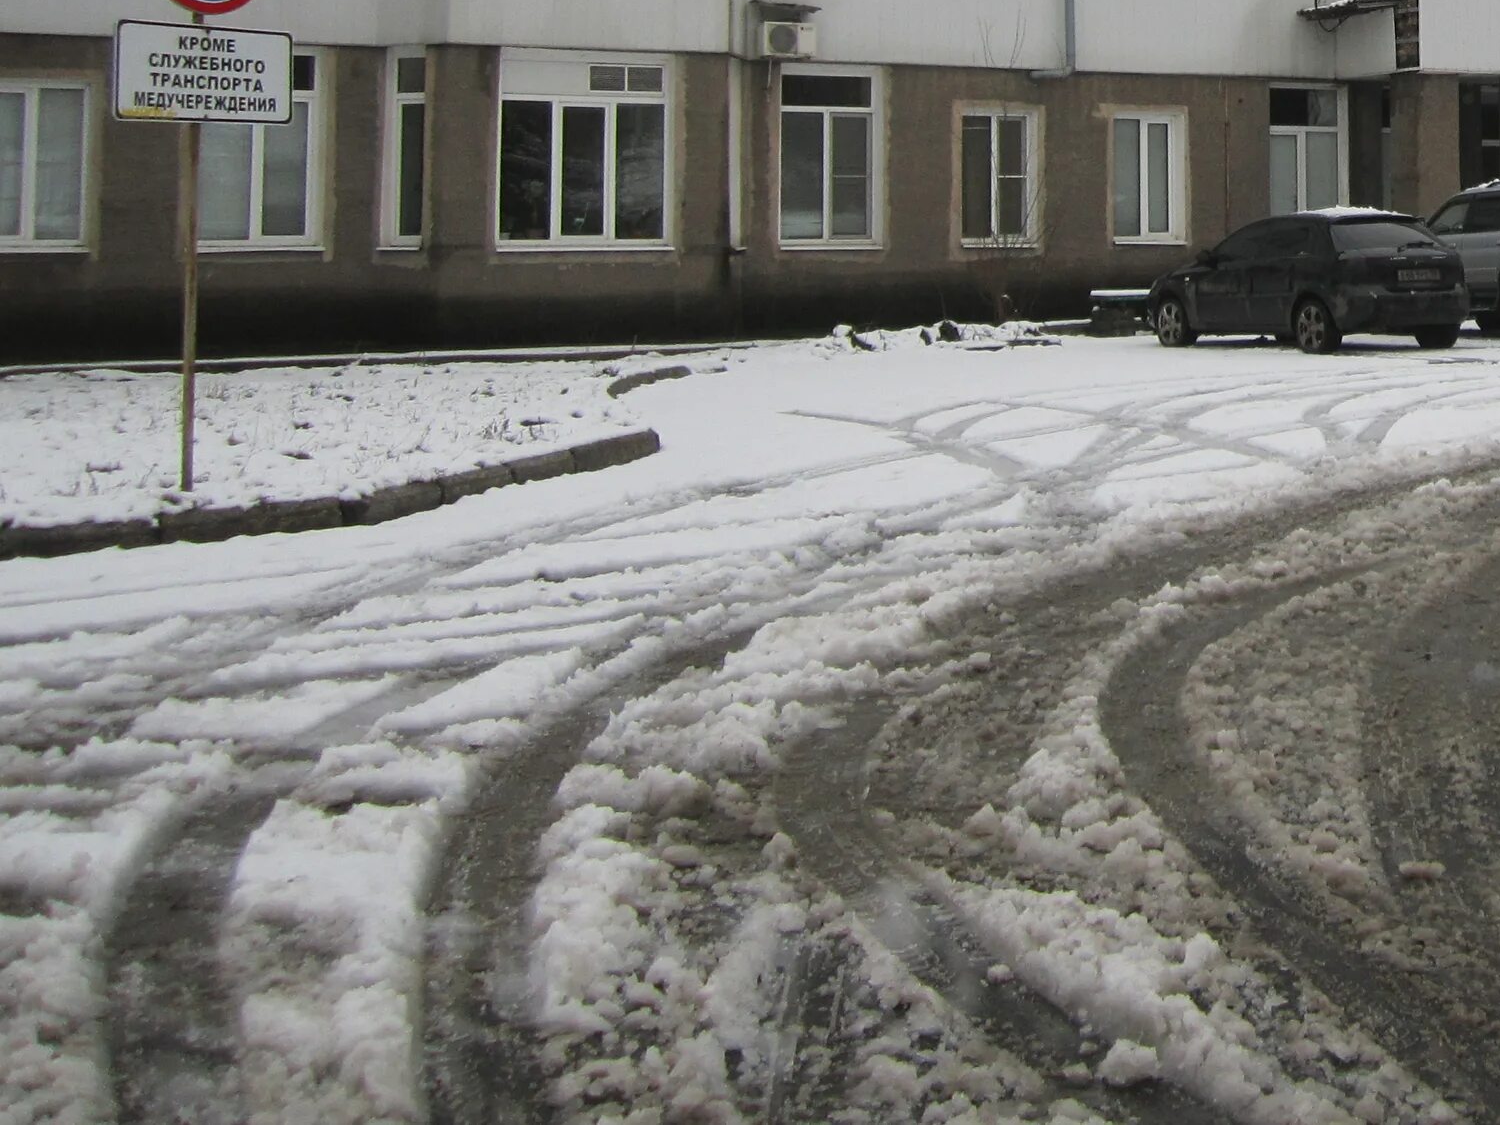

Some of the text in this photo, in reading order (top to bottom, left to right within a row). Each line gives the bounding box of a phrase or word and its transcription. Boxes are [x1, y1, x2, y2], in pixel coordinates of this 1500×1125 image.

[178, 36, 236, 53] КРОМЕ
[149, 52, 266, 74] СЛУЖЕБНОГО
[150, 72, 264, 93] ТРАНСПОРТА
[134, 91, 277, 114] МЕДУЧЕРЕЖДЕНИЯ
